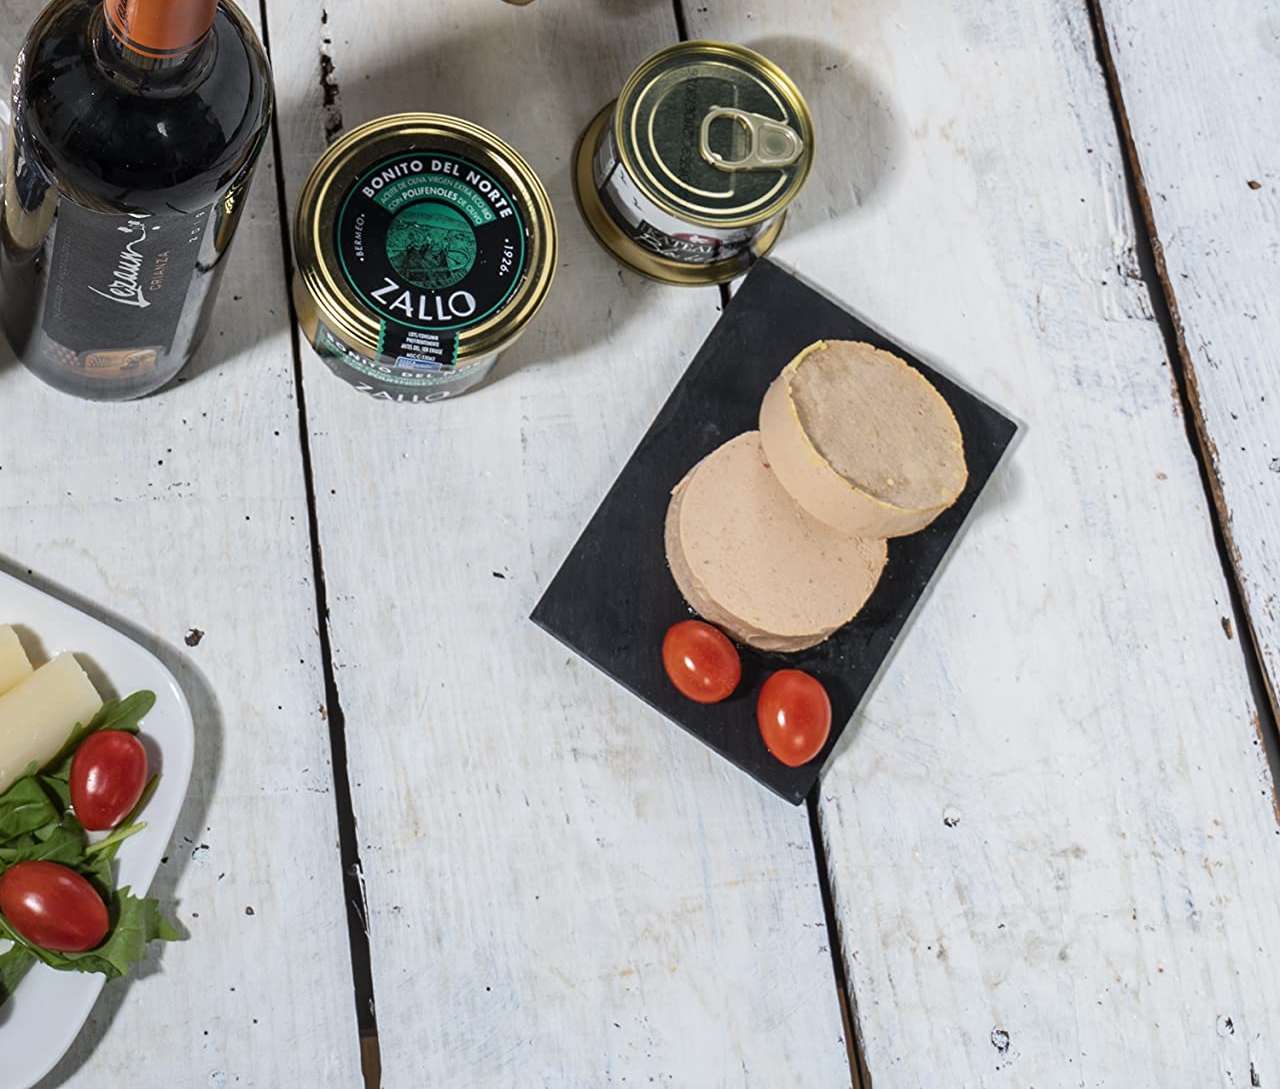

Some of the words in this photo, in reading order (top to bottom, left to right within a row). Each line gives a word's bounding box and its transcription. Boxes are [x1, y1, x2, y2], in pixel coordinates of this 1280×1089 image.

[362, 160, 423, 198] BONITO
[431, 160, 461, 177] DEL
[465, 171, 513, 219] NORTE
[388, 197, 404, 210] CON
[401, 186, 458, 201] POLIFENOLES
[457, 196, 467, 207] DE
[398, 181, 407, 190] DE
[407, 176, 427, 186] OLIVA
[427, 175, 454, 187] VIRGEN
[453, 182, 472, 197] EXTRA
[354, 217, 365, 257] BERMEO
[149, 249, 171, 292] CRIANZA
[501, 243, 514, 272] 1926
[370, 277, 476, 321] ZALLO
[401, 369, 433, 379] DEL
